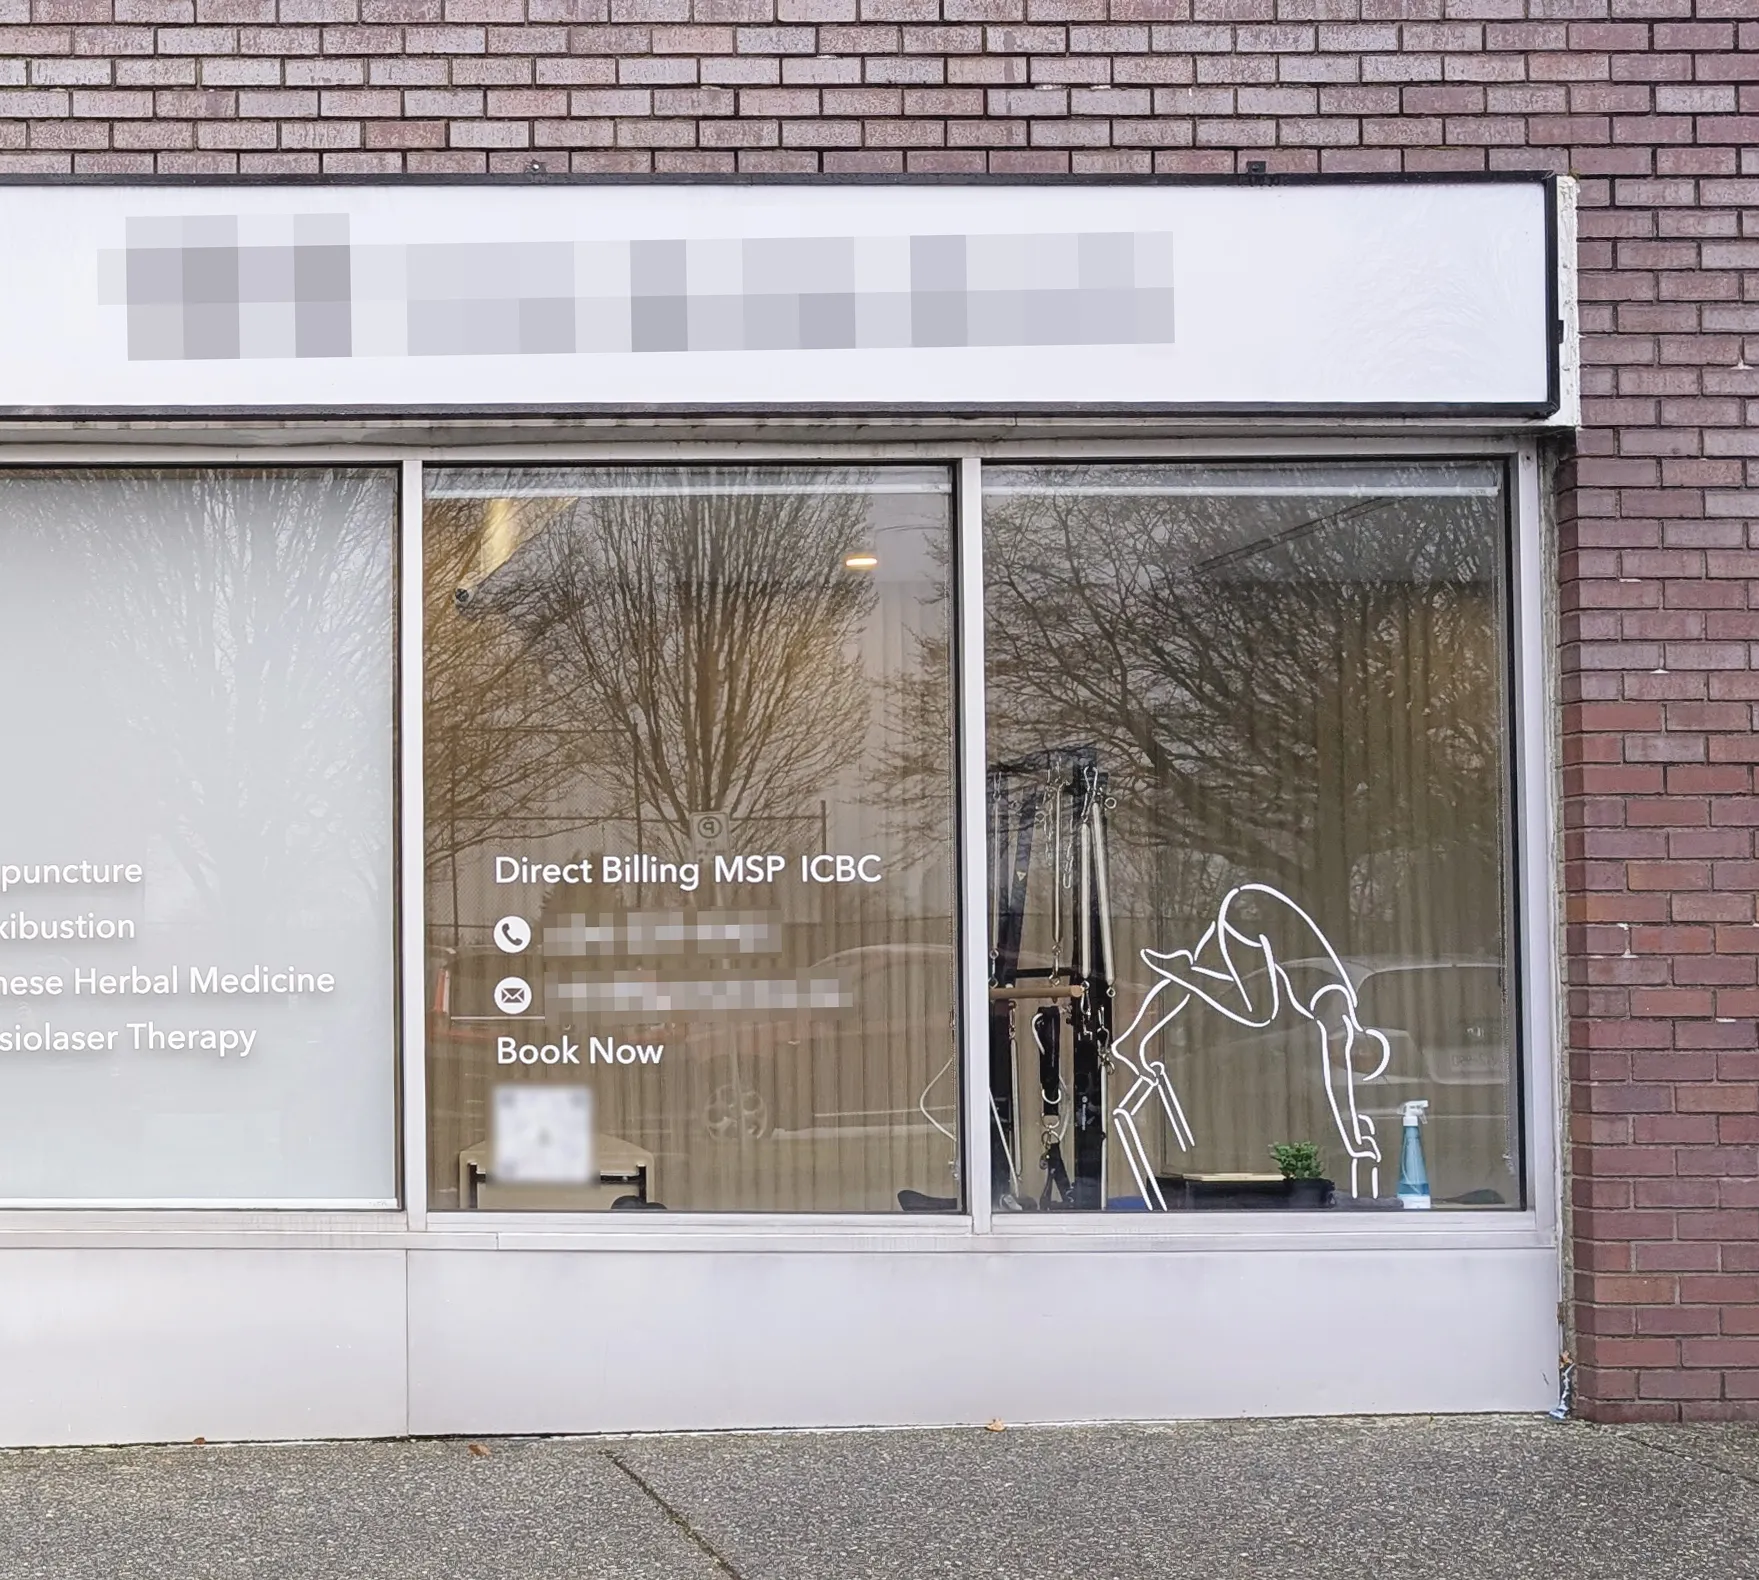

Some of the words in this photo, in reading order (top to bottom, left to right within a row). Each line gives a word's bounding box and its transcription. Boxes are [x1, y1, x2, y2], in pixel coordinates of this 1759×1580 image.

[495, 856, 592, 884] Direct
[602, 854, 699, 891] Billing
[715, 855, 785, 883] MSP
[802, 854, 882, 883] ICBC
[74, 965, 178, 995] Herbal
[189, 963, 335, 994] Medicine
[126, 1021, 257, 1058] Therapy
[497, 1035, 580, 1065] Book
[589, 1036, 664, 1065] Now
